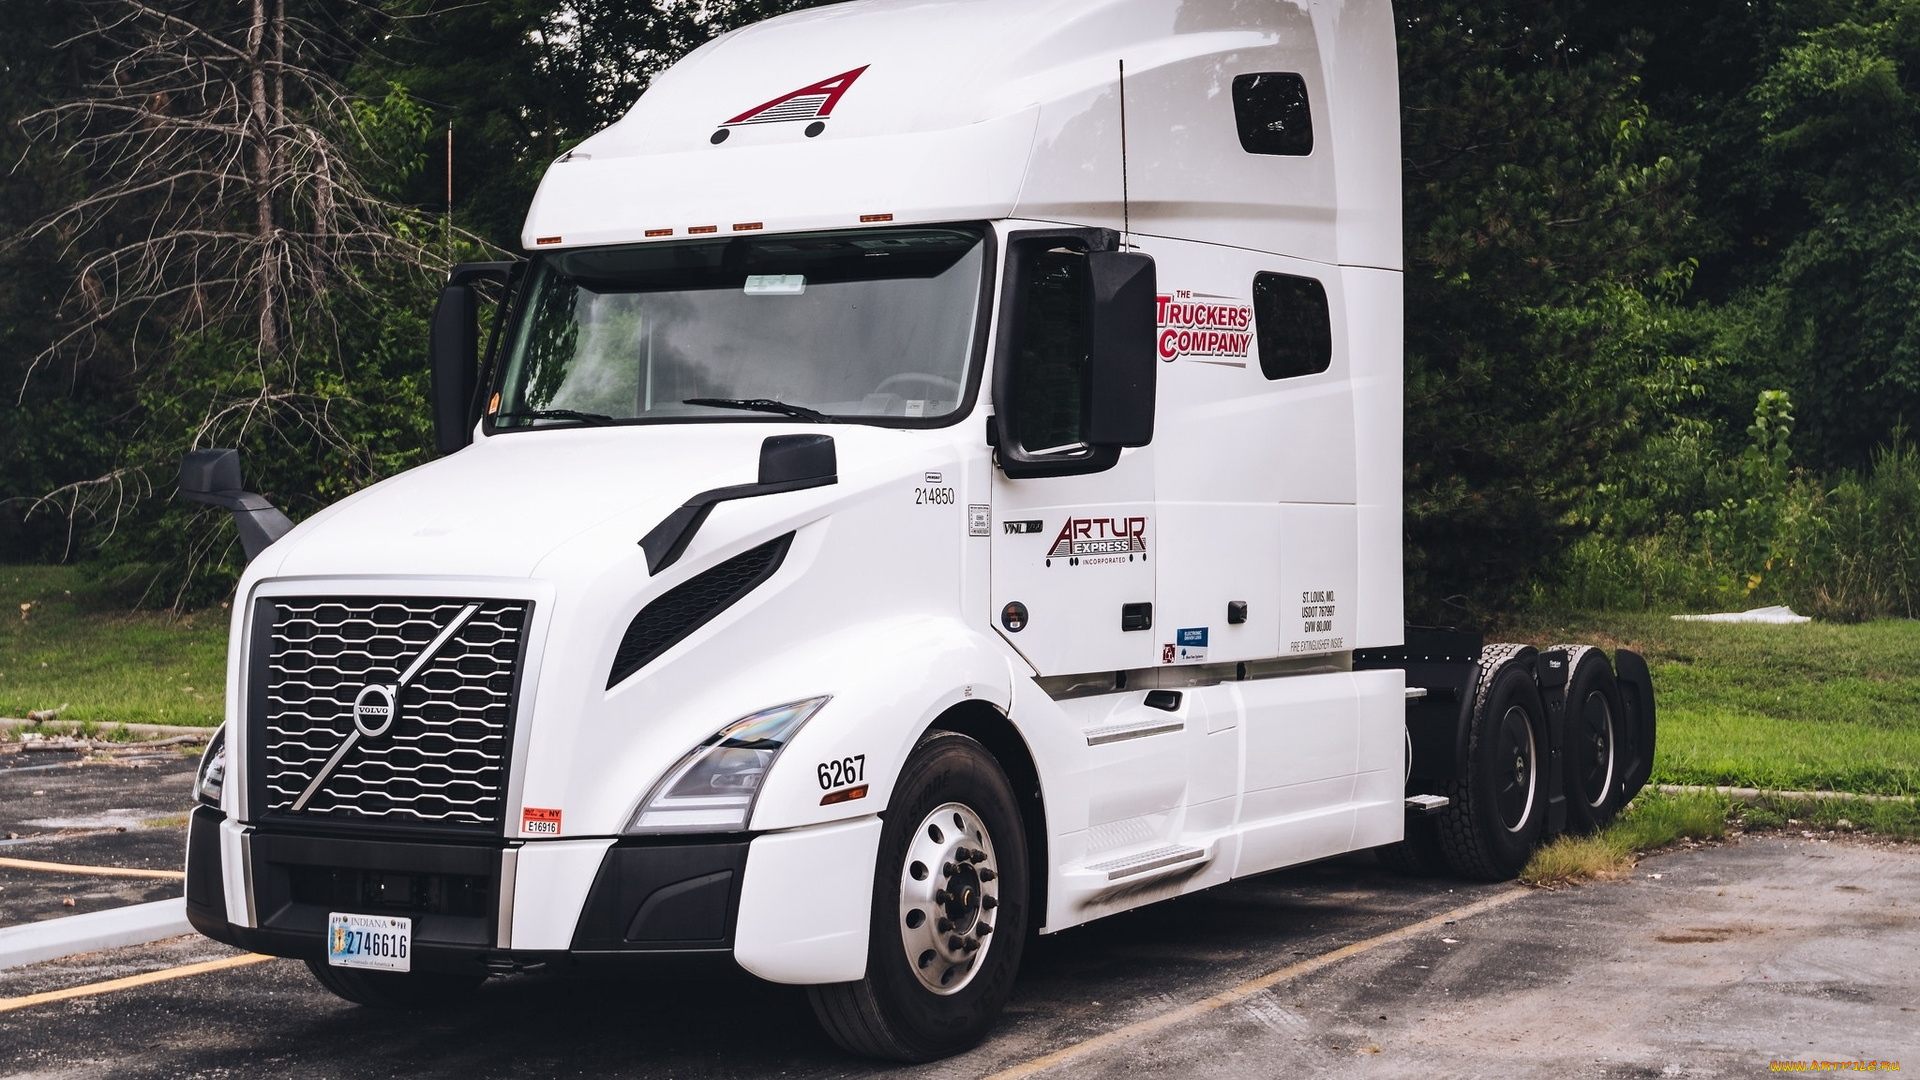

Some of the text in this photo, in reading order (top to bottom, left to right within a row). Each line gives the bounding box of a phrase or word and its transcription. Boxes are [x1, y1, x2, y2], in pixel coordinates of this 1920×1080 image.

[1176, 290, 1191, 299] THE
[1156, 296, 1251, 328] TRUCKERS'
[1159, 329, 1251, 359] COMPANY
[915, 487, 955, 505] 214850
[1047, 516, 1146, 556] ARTUR
[1074, 541, 1129, 554] EXPRESS
[1083, 557, 1126, 565] INCORPORATED
[1302, 606, 1318, 618] USDOT
[1304, 620, 1332, 633] GVW 80,000
[817, 754, 865, 790] 6267
[528, 821, 556, 832] E16916
[350, 917, 388, 928] INDIANA
[347, 931, 407, 959] 2746616
